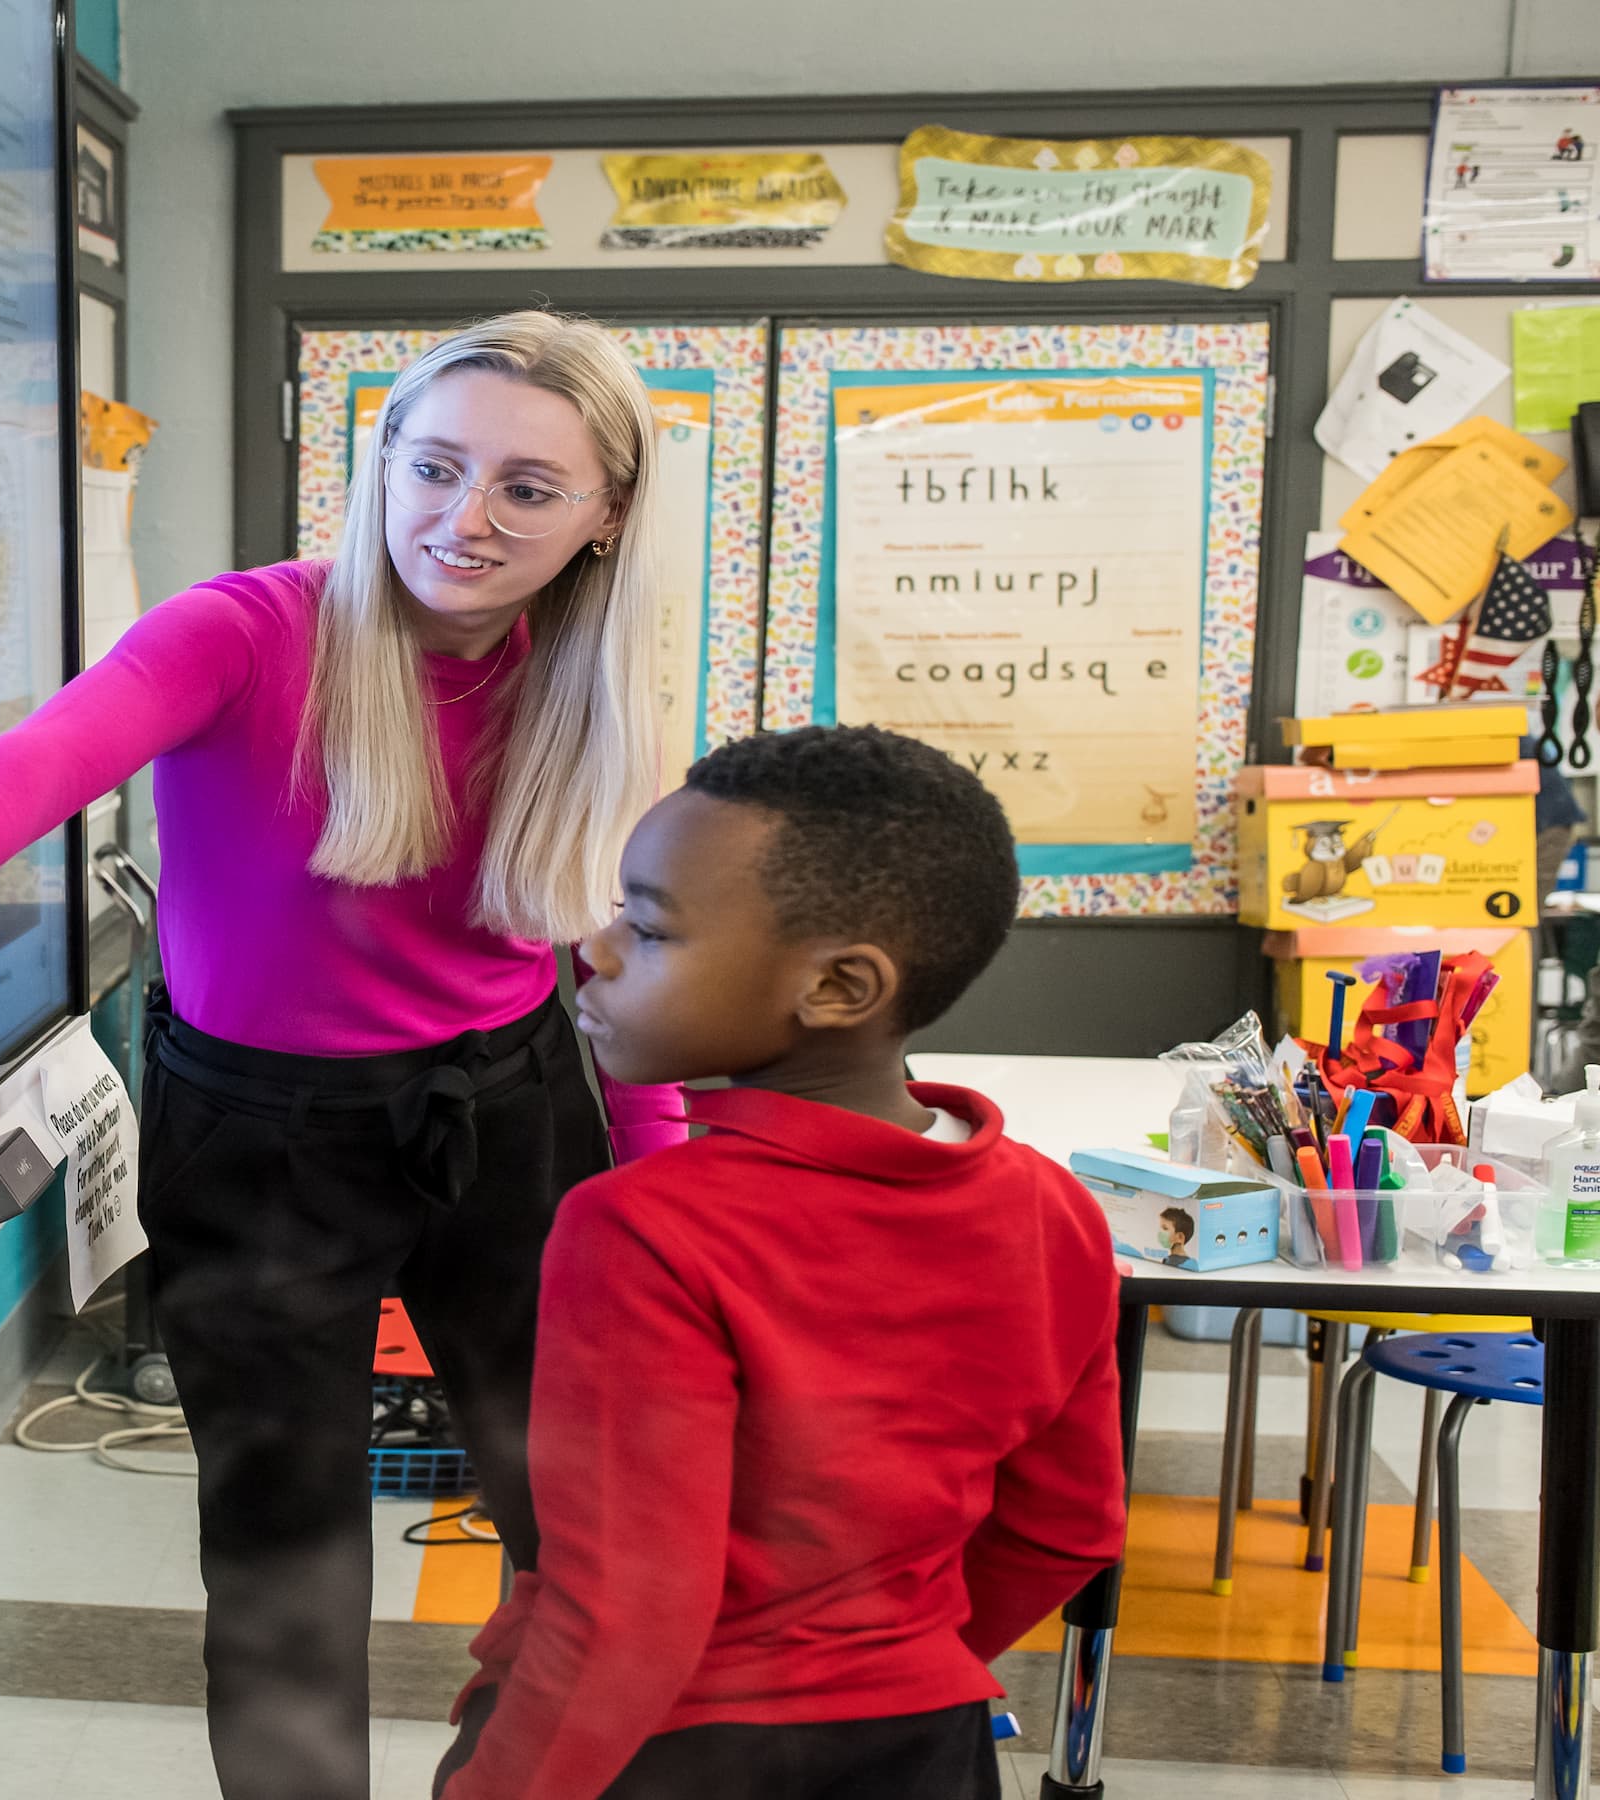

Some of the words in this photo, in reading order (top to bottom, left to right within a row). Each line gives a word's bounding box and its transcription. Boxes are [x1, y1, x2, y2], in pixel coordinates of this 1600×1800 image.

[631, 175, 741, 202] ADVENTURE
[755, 174, 827, 202] AWAITS
[968, 210, 1039, 237] MAKE
[1145, 213, 1218, 240] MARK
[1491, 892, 1511, 917] 1
[50, 1110, 77, 1138] Please
[70, 1100, 84, 1122] do
[80, 1092, 94, 1117] not
[87, 1214, 105, 1247] Thank
[102, 1201, 115, 1229] You
